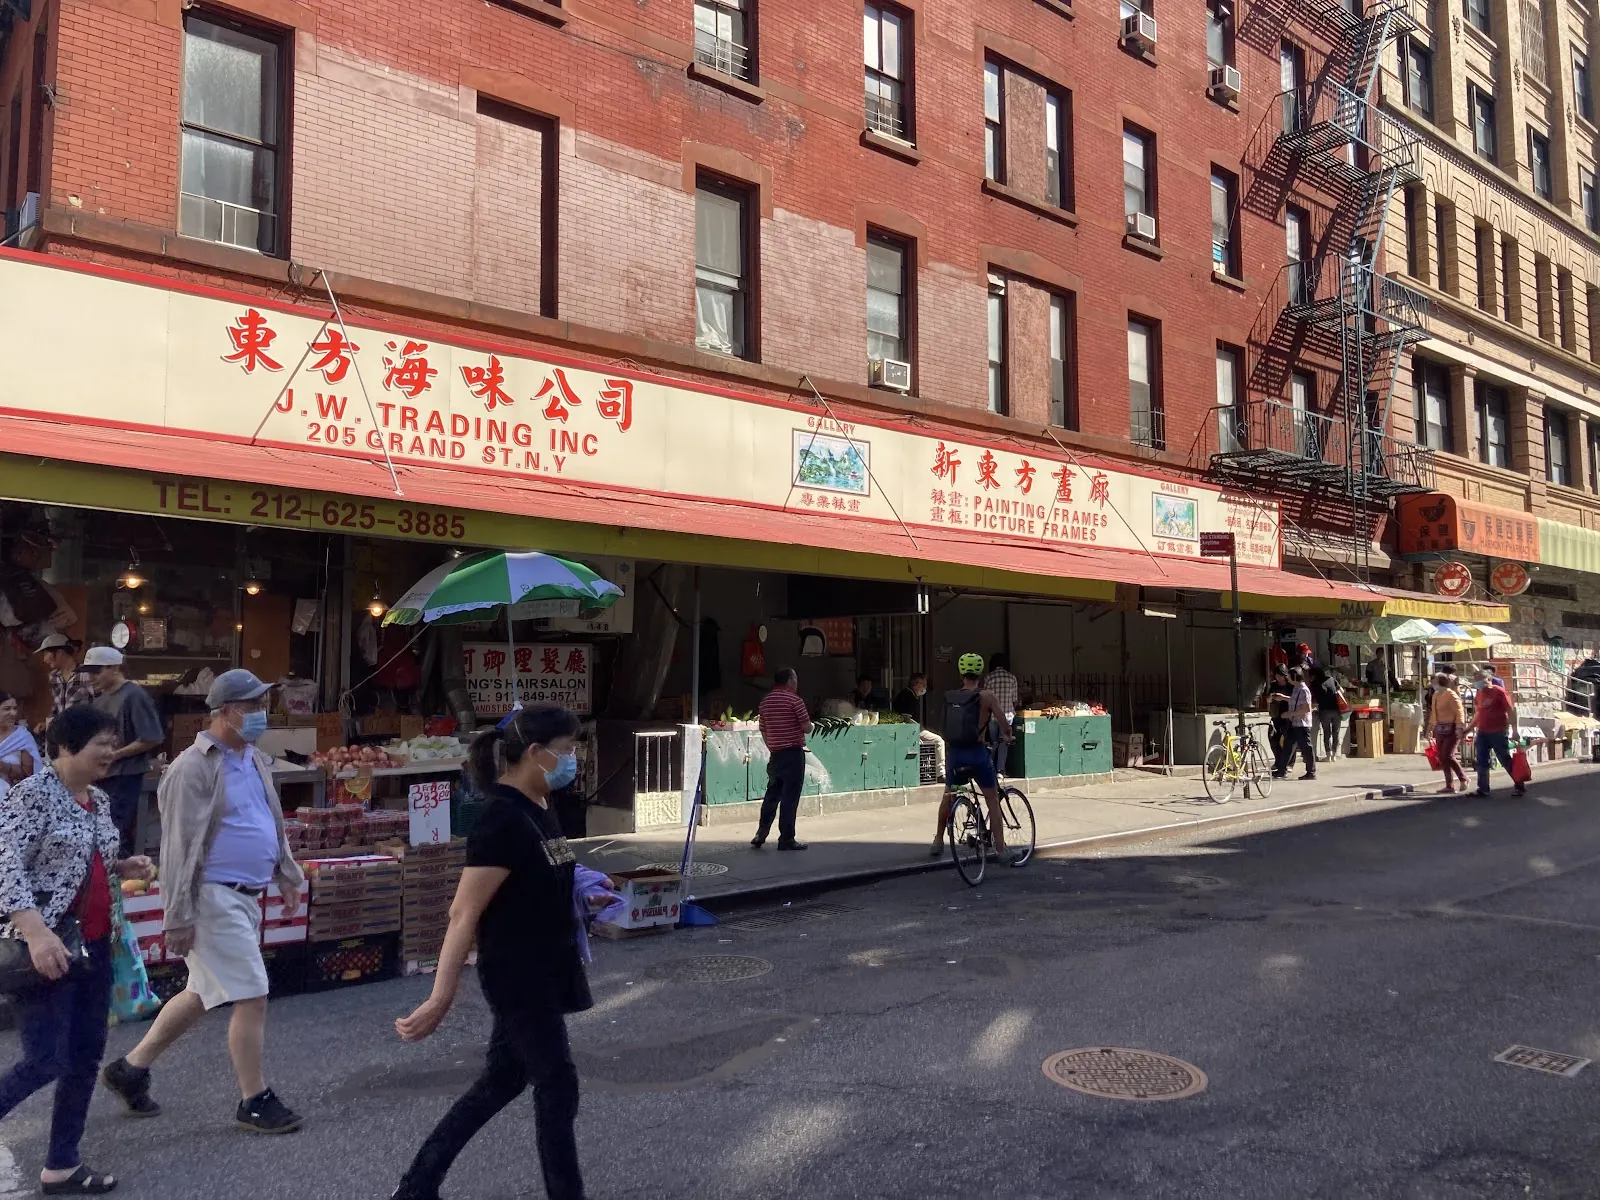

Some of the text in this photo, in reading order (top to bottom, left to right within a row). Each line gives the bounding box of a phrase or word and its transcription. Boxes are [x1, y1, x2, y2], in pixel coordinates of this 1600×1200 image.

[220, 308, 634, 433] 東方海味公司
[307, 422, 357, 446] 205
[366, 429, 466, 460] GRAND
[376, 402, 533, 448] TRADING
[549, 428, 599, 457] INC
[807, 416, 856, 435] GALLERY
[930, 441, 1110, 510] 新東方畫廊
[1160, 482, 1190, 496] GALLERY
[152, 480, 466, 539] TEL: 212-625-3885
[973, 495, 1046, 519] PAINTING
[1053, 507, 1108, 528] FRAMES
[973, 512, 1035, 534] PICTURE
[1043, 522, 1097, 541] FRAMES
[468, 678, 586, 690] NG'S HAIR SALON
[469, 692, 490, 702] EL:
[475, 704, 491, 712] AND
